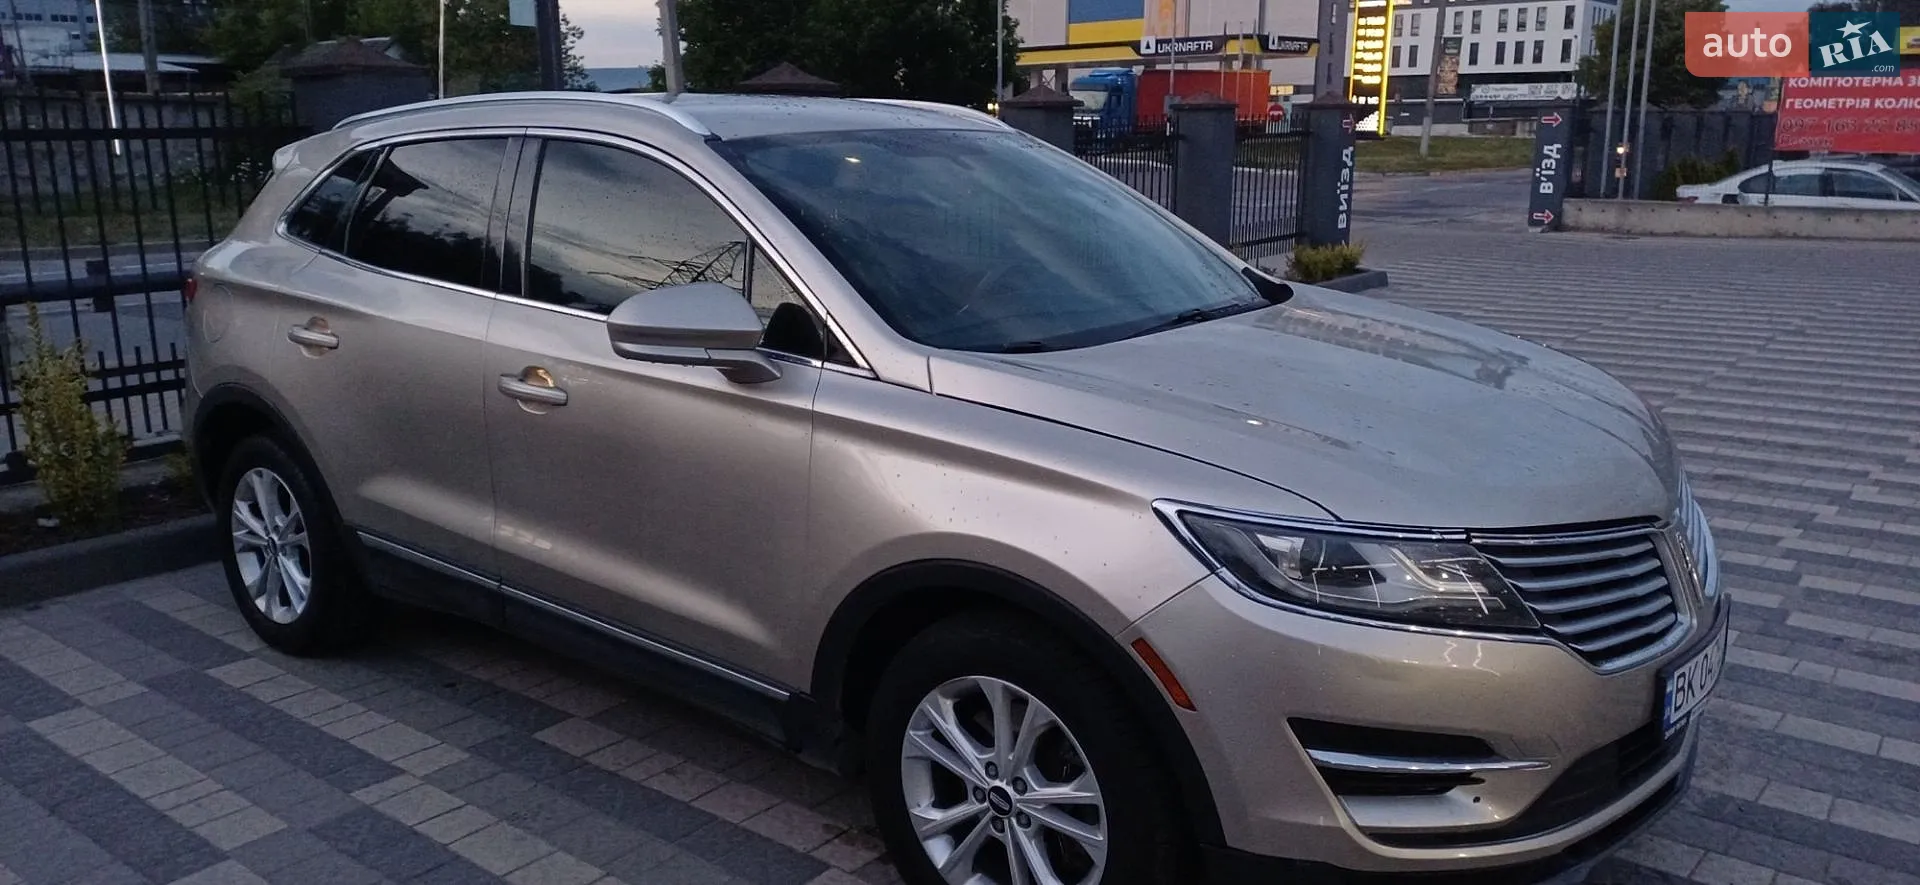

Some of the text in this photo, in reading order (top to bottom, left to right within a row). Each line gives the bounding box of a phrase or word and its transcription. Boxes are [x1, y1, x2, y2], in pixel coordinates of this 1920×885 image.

[1157, 40, 1214, 53] UKRNAFTA
[1788, 76, 1904, 88] КОМП'ЮТЕРНА
[1785, 98, 1871, 109] ГЕОМЕТРІЯ
[1336, 146, 1354, 229] ВИЇЗД
[1674, 660, 1698, 713] BK
